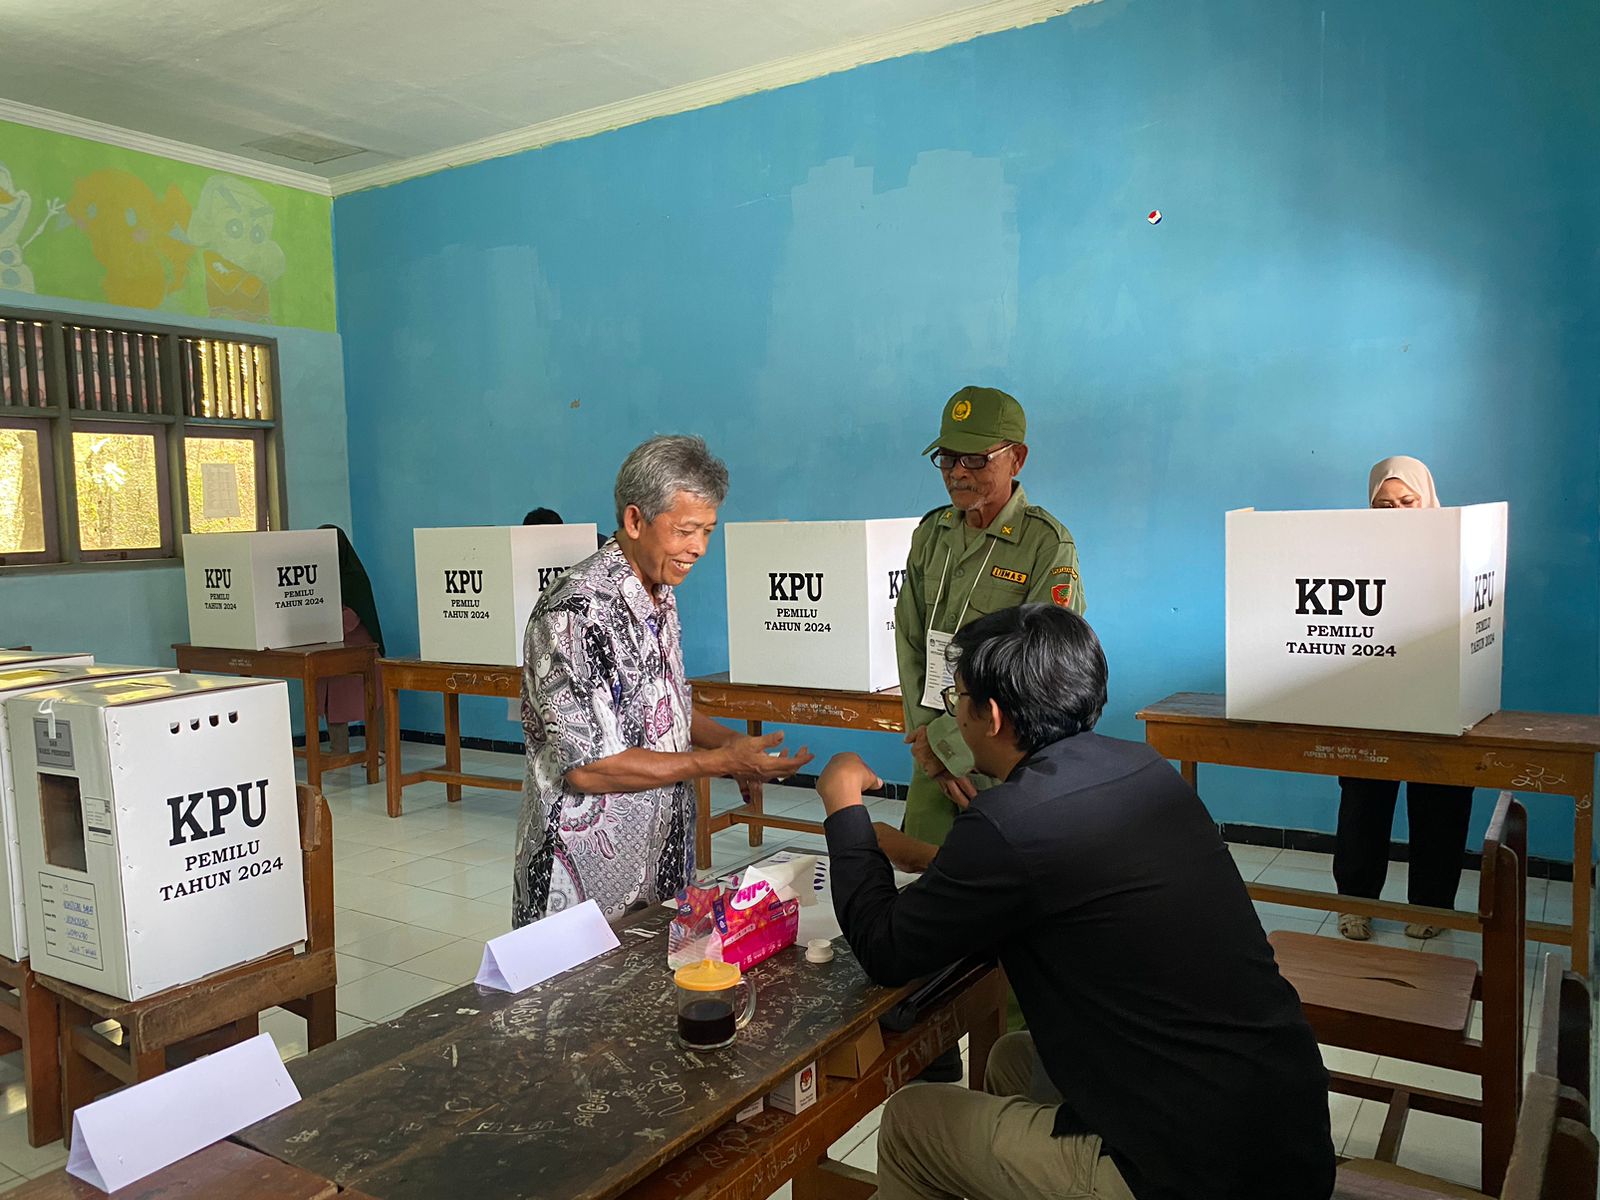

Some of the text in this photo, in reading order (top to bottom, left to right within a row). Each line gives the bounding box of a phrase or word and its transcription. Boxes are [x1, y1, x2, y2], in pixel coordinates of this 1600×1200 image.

[205, 569, 231, 588] KPU
[277, 564, 318, 587] KPU
[445, 570, 483, 593] KPU
[537, 566, 571, 592] KP
[284, 589, 314, 598] PEMILU
[769, 573, 823, 601] KPU
[1473, 570, 1495, 613] KPU
[204, 602, 222, 610] TAHUN
[275, 597, 324, 609] TAHUN 2024
[451, 600, 480, 608] PEMILU
[1295, 578, 1386, 616] KPU
[443, 610, 490, 619] TAHUN 2024
[777, 608, 818, 618] PEMILU
[764, 621, 832, 633] TAHUN 2024
[1307, 625, 1375, 638] PEMILU
[1286, 642, 1397, 657] TAHUN 2024
[167, 779, 269, 847] KPU
[184, 840, 260, 872] PEMILU
[159, 856, 284, 901] TAHUN 2024
